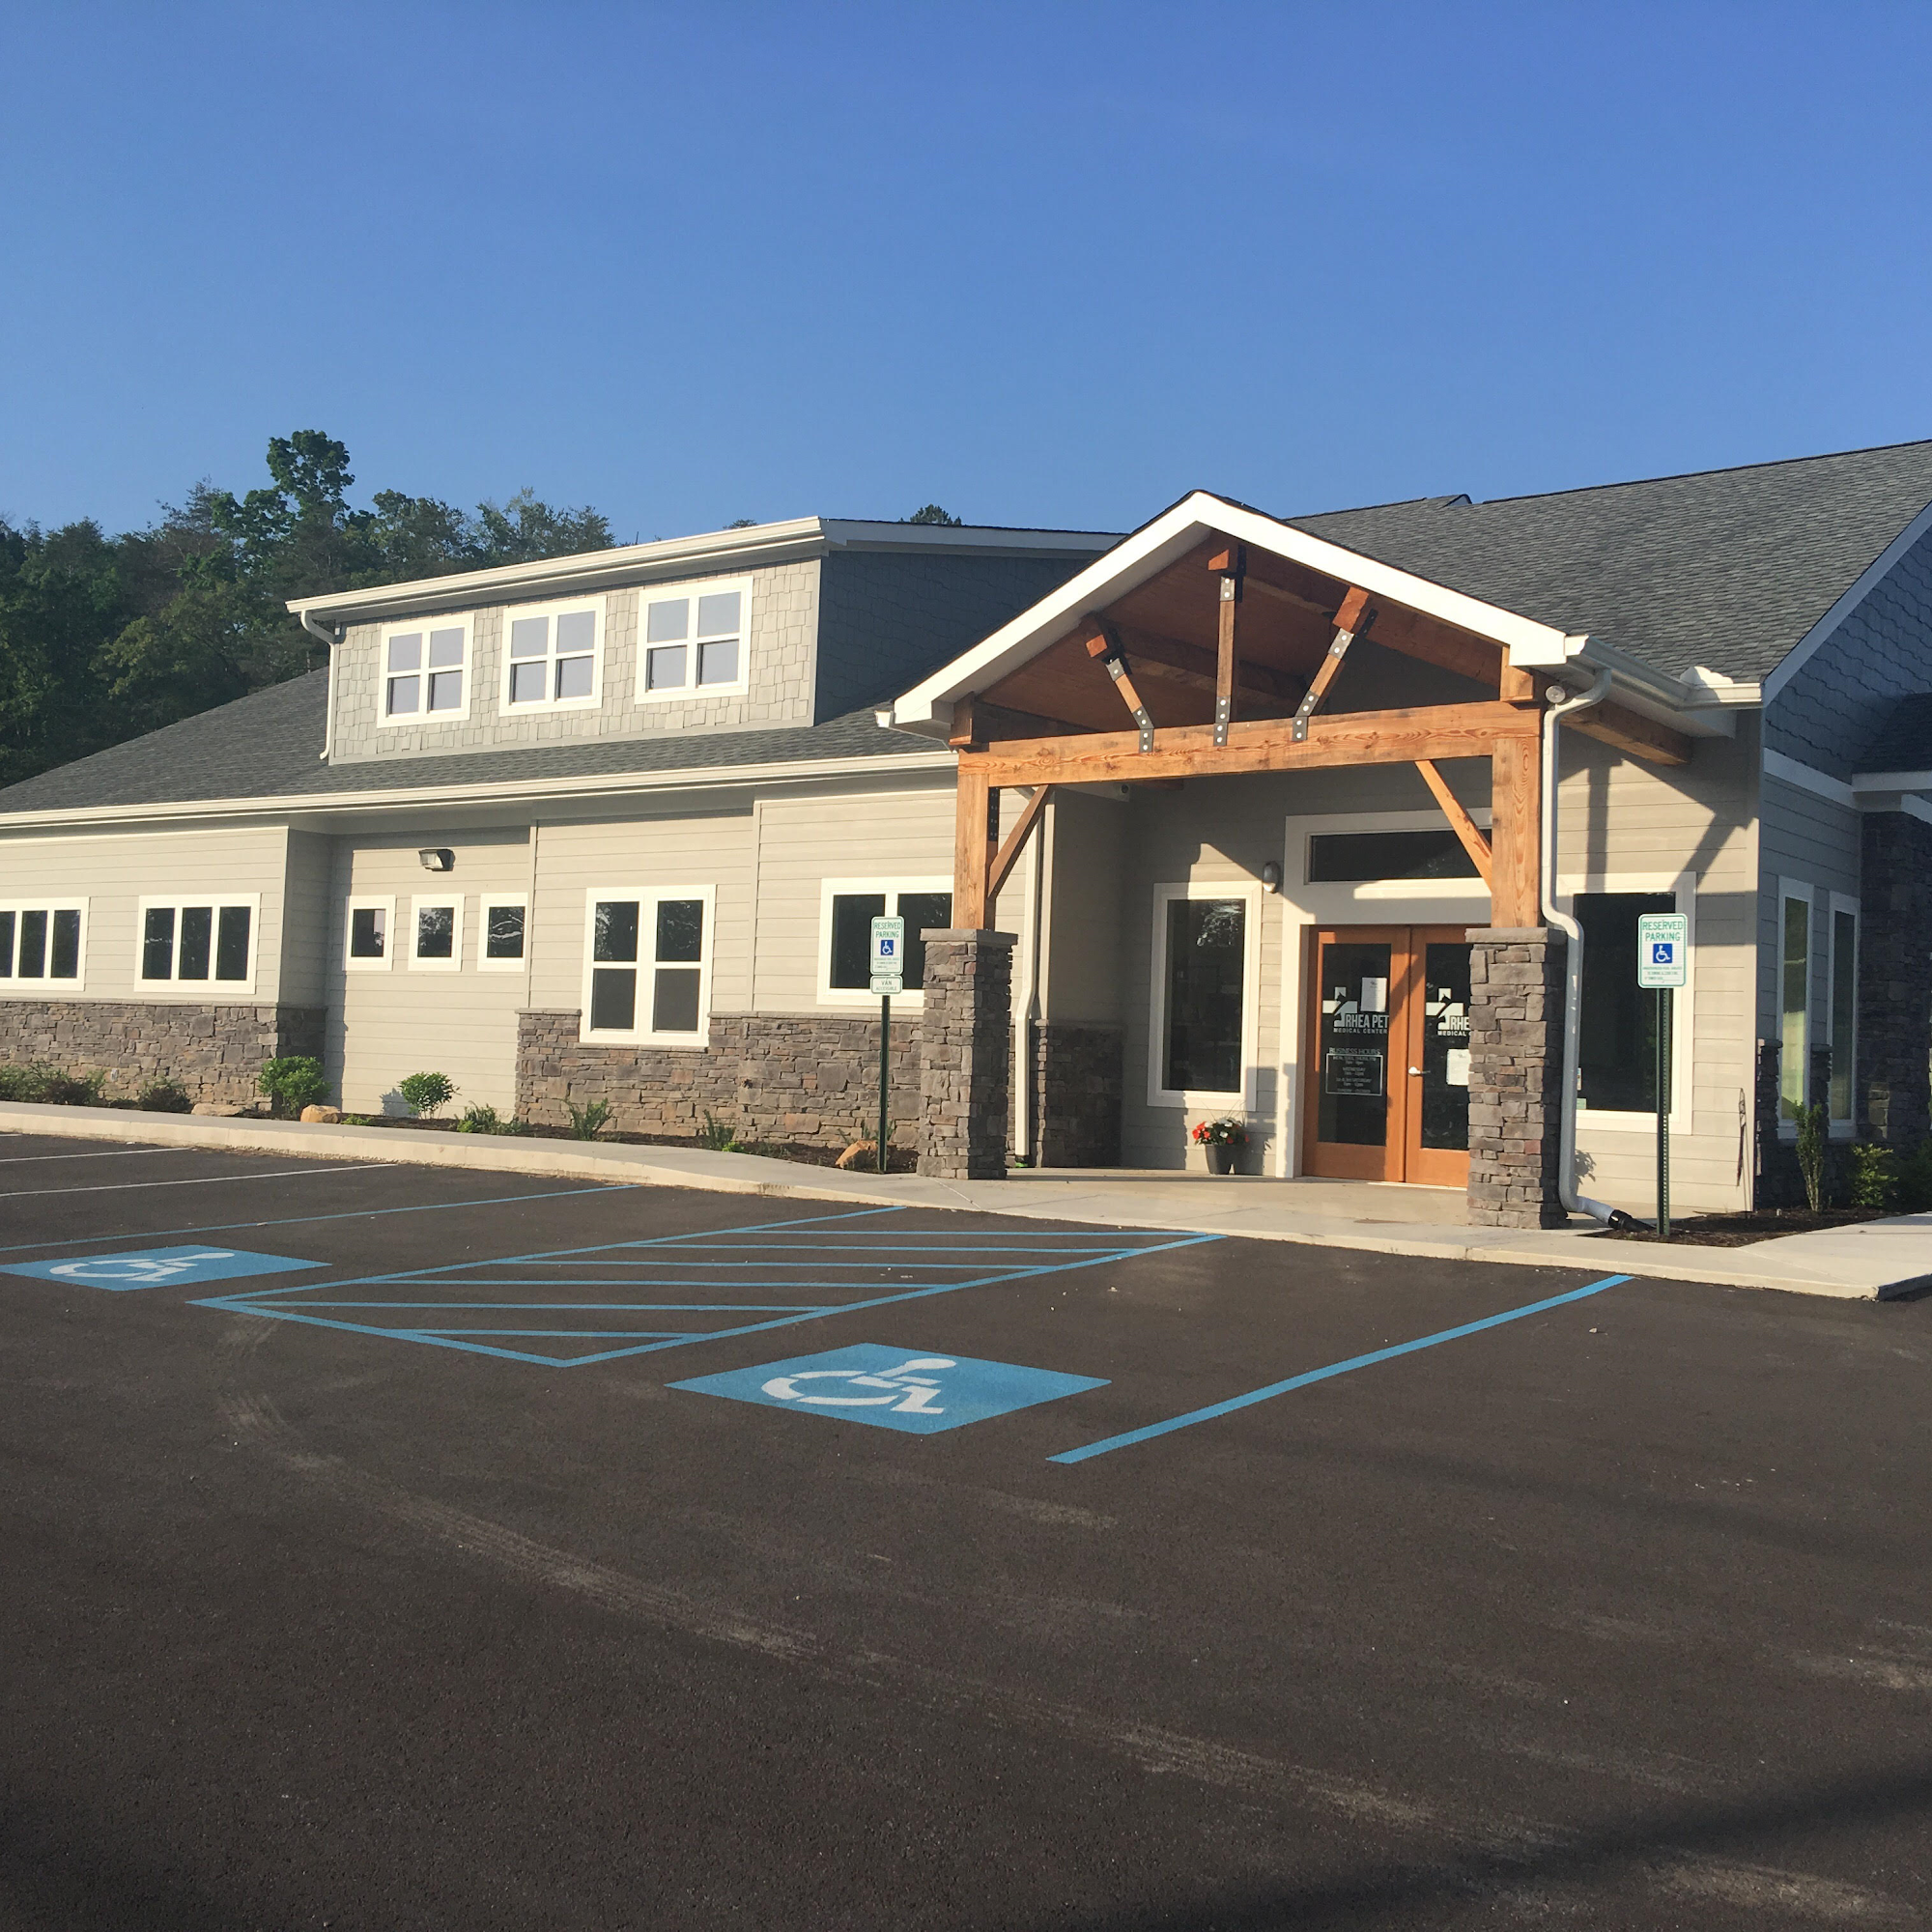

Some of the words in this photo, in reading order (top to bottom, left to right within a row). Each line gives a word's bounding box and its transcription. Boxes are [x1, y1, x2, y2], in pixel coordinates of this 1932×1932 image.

[1642, 921, 1683, 930] RESERVED
[1645, 932, 1681, 941] PARKING
[1345, 1014, 1370, 1028] RHEA
[1372, 1014, 1389, 1029] PET
[1450, 1016, 1469, 1031] RHE
